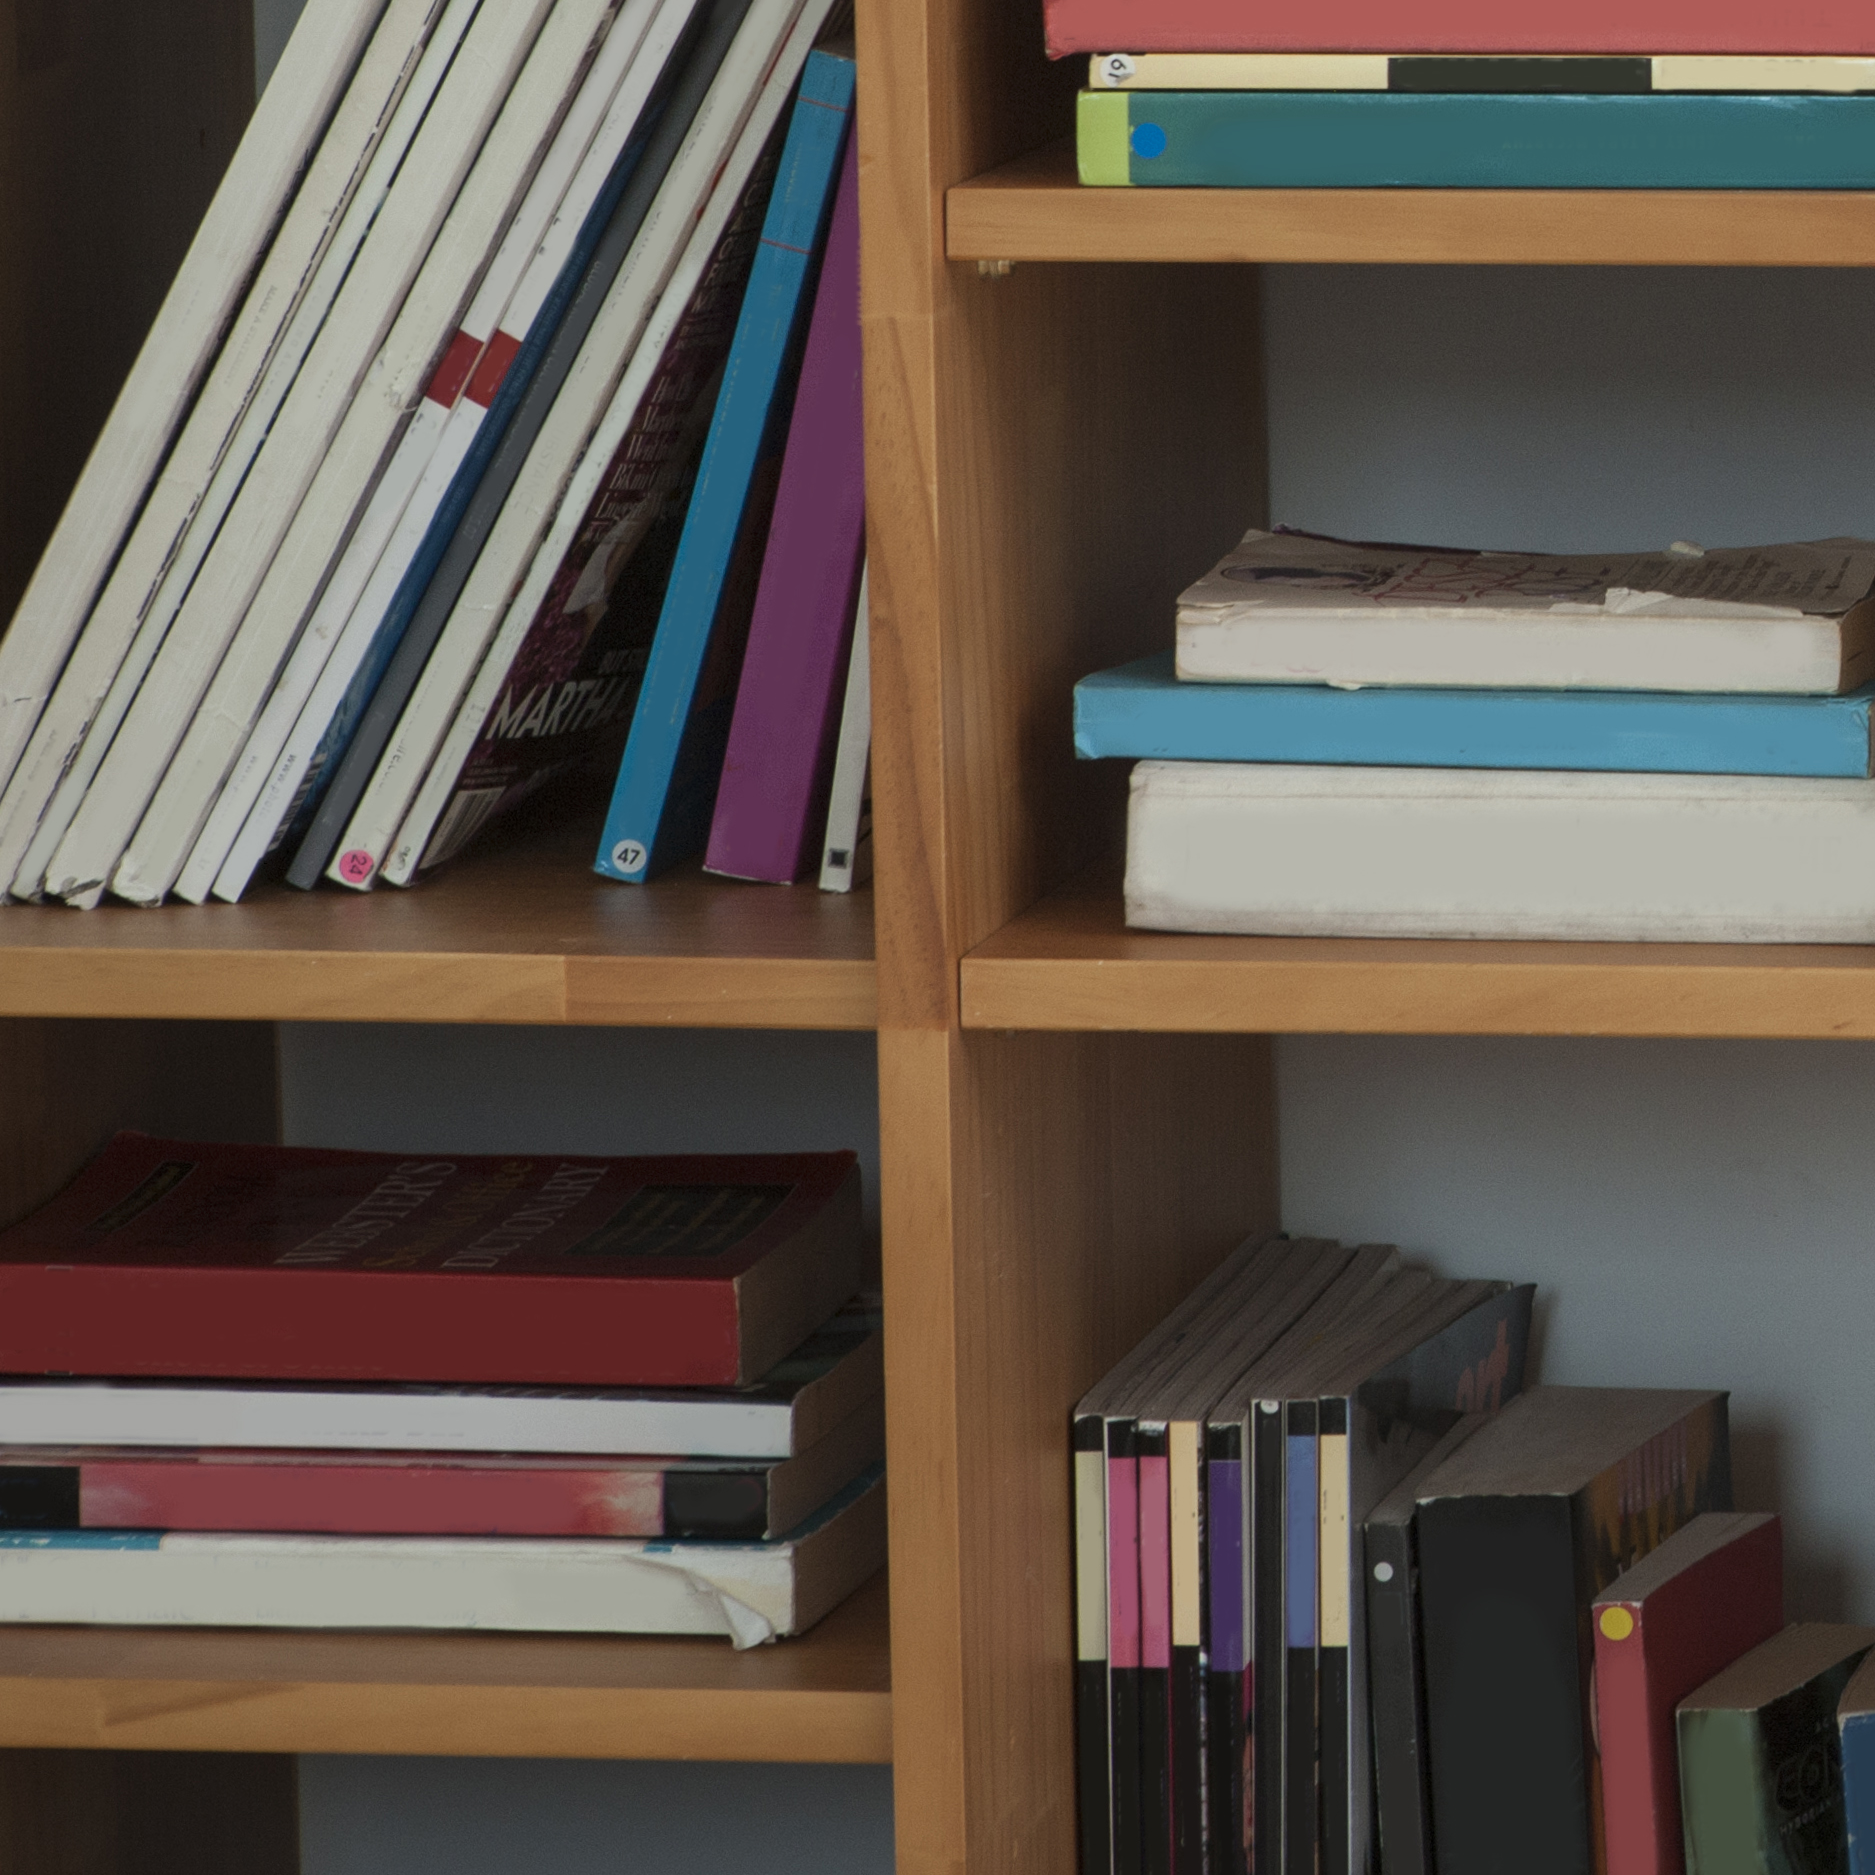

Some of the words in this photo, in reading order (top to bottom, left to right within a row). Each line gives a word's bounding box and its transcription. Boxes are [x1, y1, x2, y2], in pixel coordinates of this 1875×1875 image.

[257, 284, 278, 316] MAKE
[346, 851, 369, 878] 24
[616, 847, 642, 866] 47
[273, 1161, 458, 1266] WEBSTER'S
[441, 1162, 609, 1270] DICTIONARY
